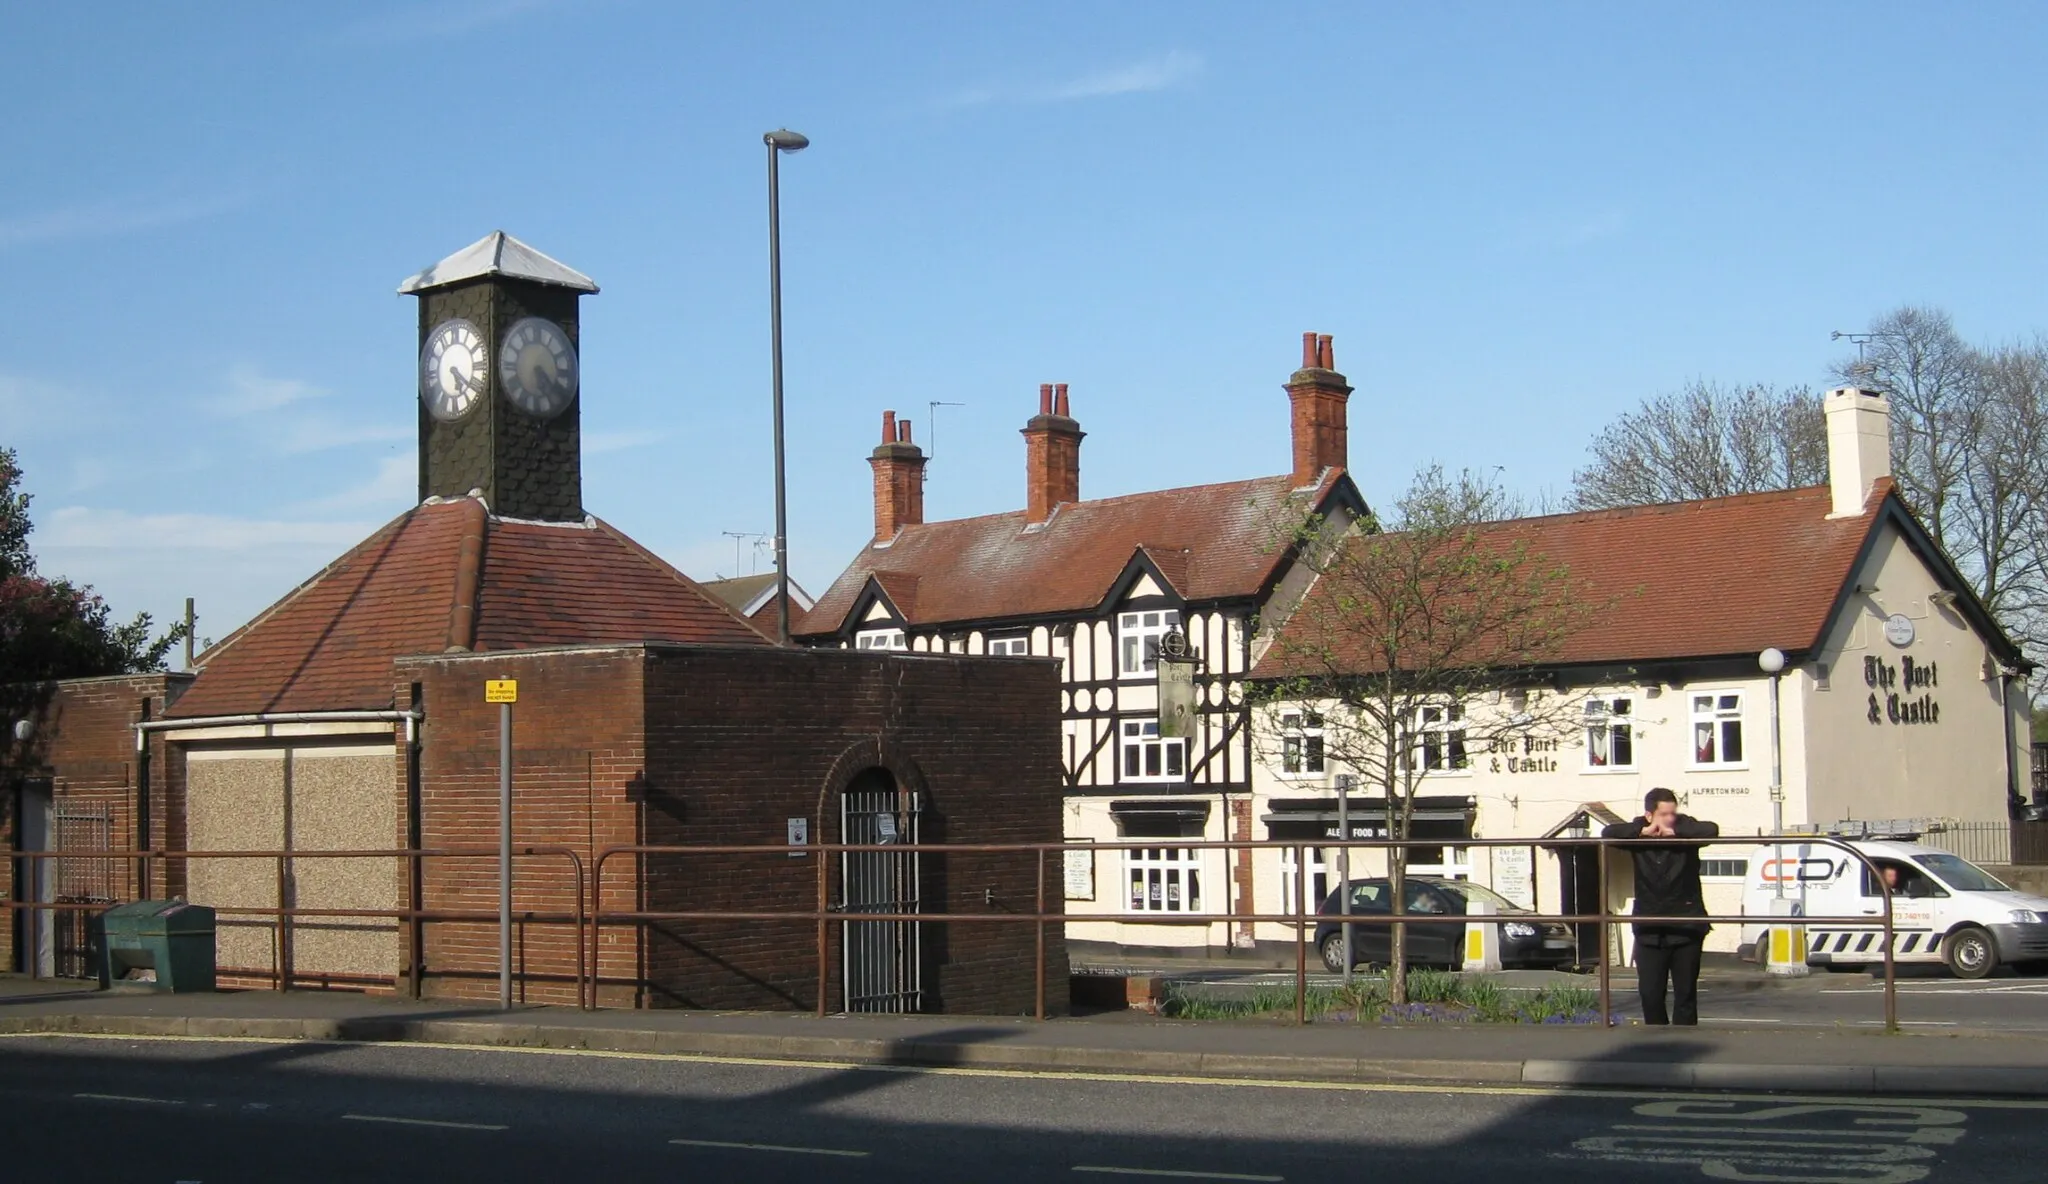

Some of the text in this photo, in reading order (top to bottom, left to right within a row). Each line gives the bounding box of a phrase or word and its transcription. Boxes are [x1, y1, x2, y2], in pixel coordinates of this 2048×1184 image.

[1864, 655, 1938, 694] The Poet
[1867, 692, 1940, 725] & Castle
[1488, 735, 1558, 755] The Poet
[1489, 756, 1557, 773] & Castle
[1692, 787, 1750, 795] ALFRETON ROAD
[1352, 828, 1373, 837] FOOD
[1547, 1100, 1968, 1184] STOP
